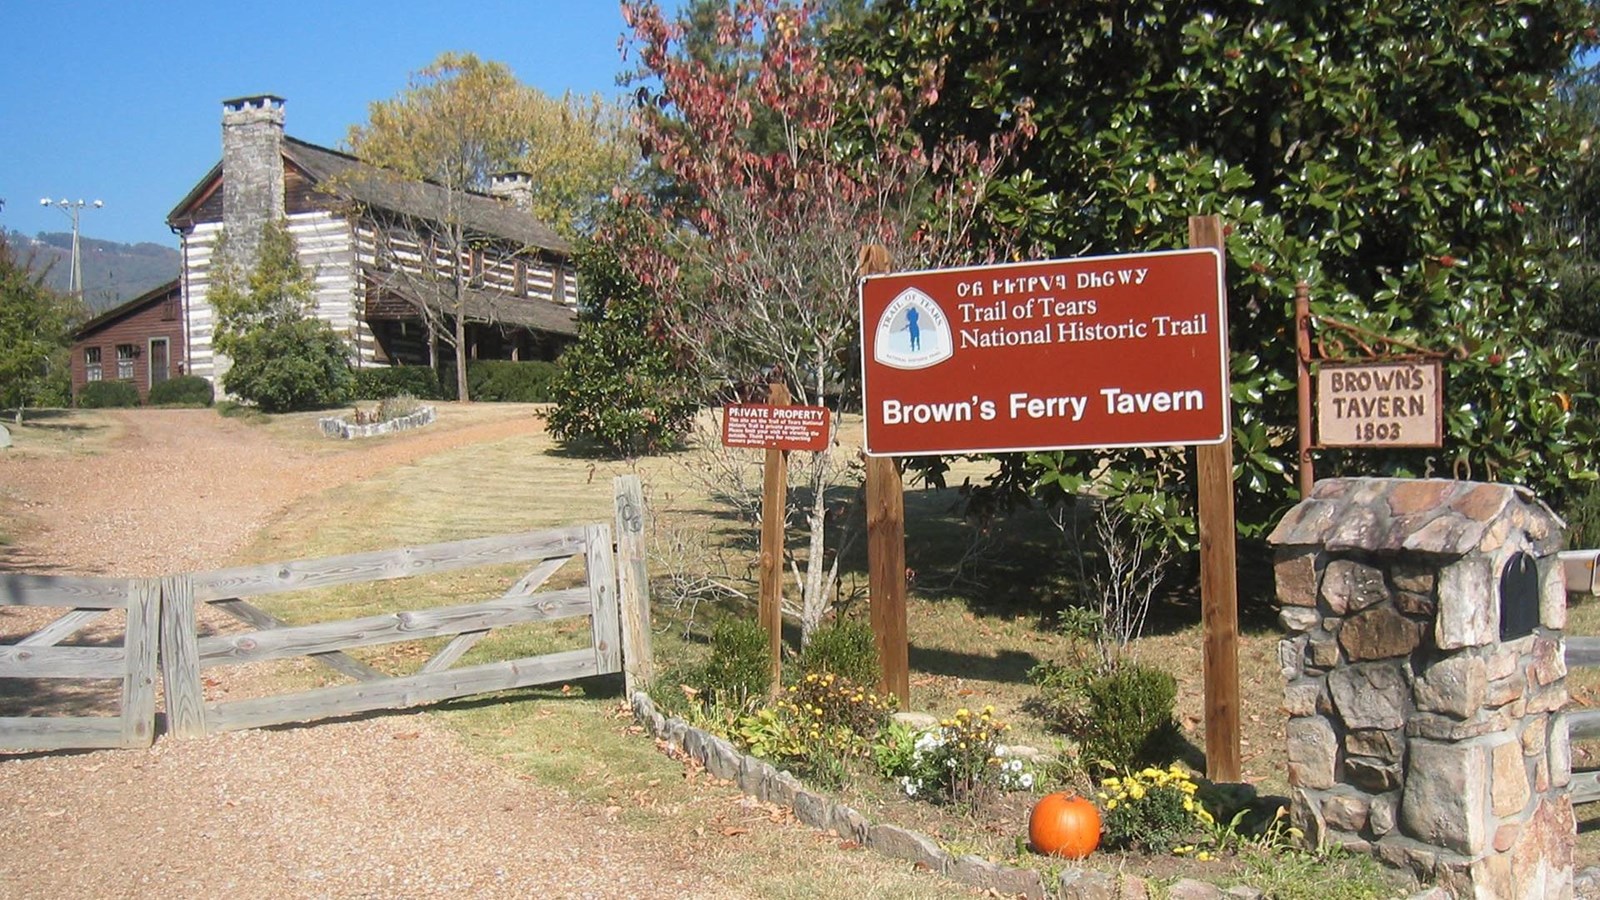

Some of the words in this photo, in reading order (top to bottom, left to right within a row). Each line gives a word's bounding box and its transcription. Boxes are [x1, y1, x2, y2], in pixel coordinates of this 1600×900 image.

[882, 301, 904, 328] TRAIL
[920, 298, 942, 326] TEARS
[958, 301, 1007, 323] Trail
[1012, 299, 1035, 319] of
[1037, 297, 1097, 318] Tears
[960, 324, 1052, 349] National
[1057, 319, 1147, 343] Historic
[1152, 314, 1208, 337] Trail
[1331, 365, 1424, 393] BROWN'S
[728, 407, 769, 418] PRIVATE
[773, 408, 824, 420] PROPERTY
[882, 395, 996, 425] Brown's
[1009, 393, 1088, 421] Ferry
[1099, 388, 1204, 415] Tavern
[1332, 395, 1424, 419] TAVERN
[1356, 422, 1401, 441] 1803
